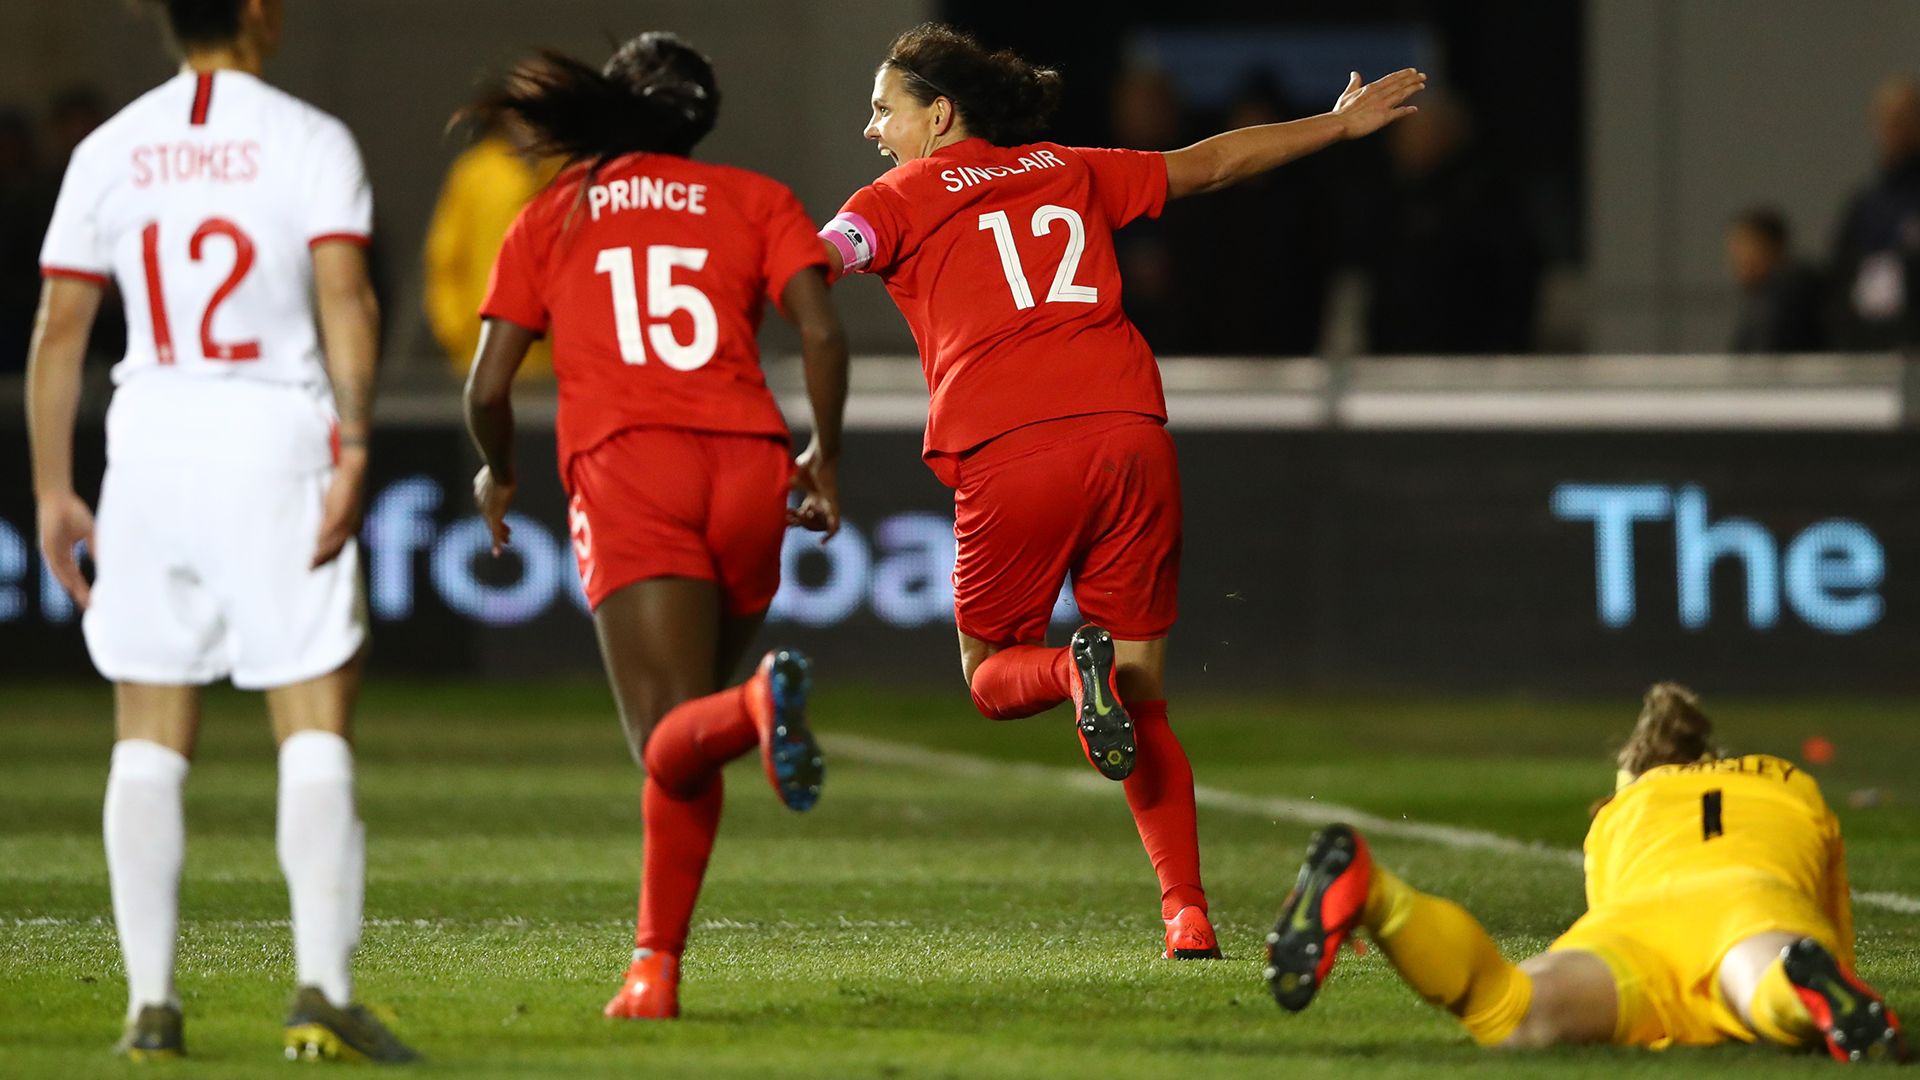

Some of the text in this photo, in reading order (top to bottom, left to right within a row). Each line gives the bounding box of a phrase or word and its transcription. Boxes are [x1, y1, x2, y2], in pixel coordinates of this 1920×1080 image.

[131, 140, 261, 189] STOKES
[587, 175, 709, 222] PRINCE
[940, 149, 1066, 193] SINCLAIR
[141, 217, 262, 366] 12
[976, 204, 1098, 311] 12
[594, 244, 719, 372] 15
[1551, 481, 1886, 633] The
[1702, 789, 1723, 841] 1
